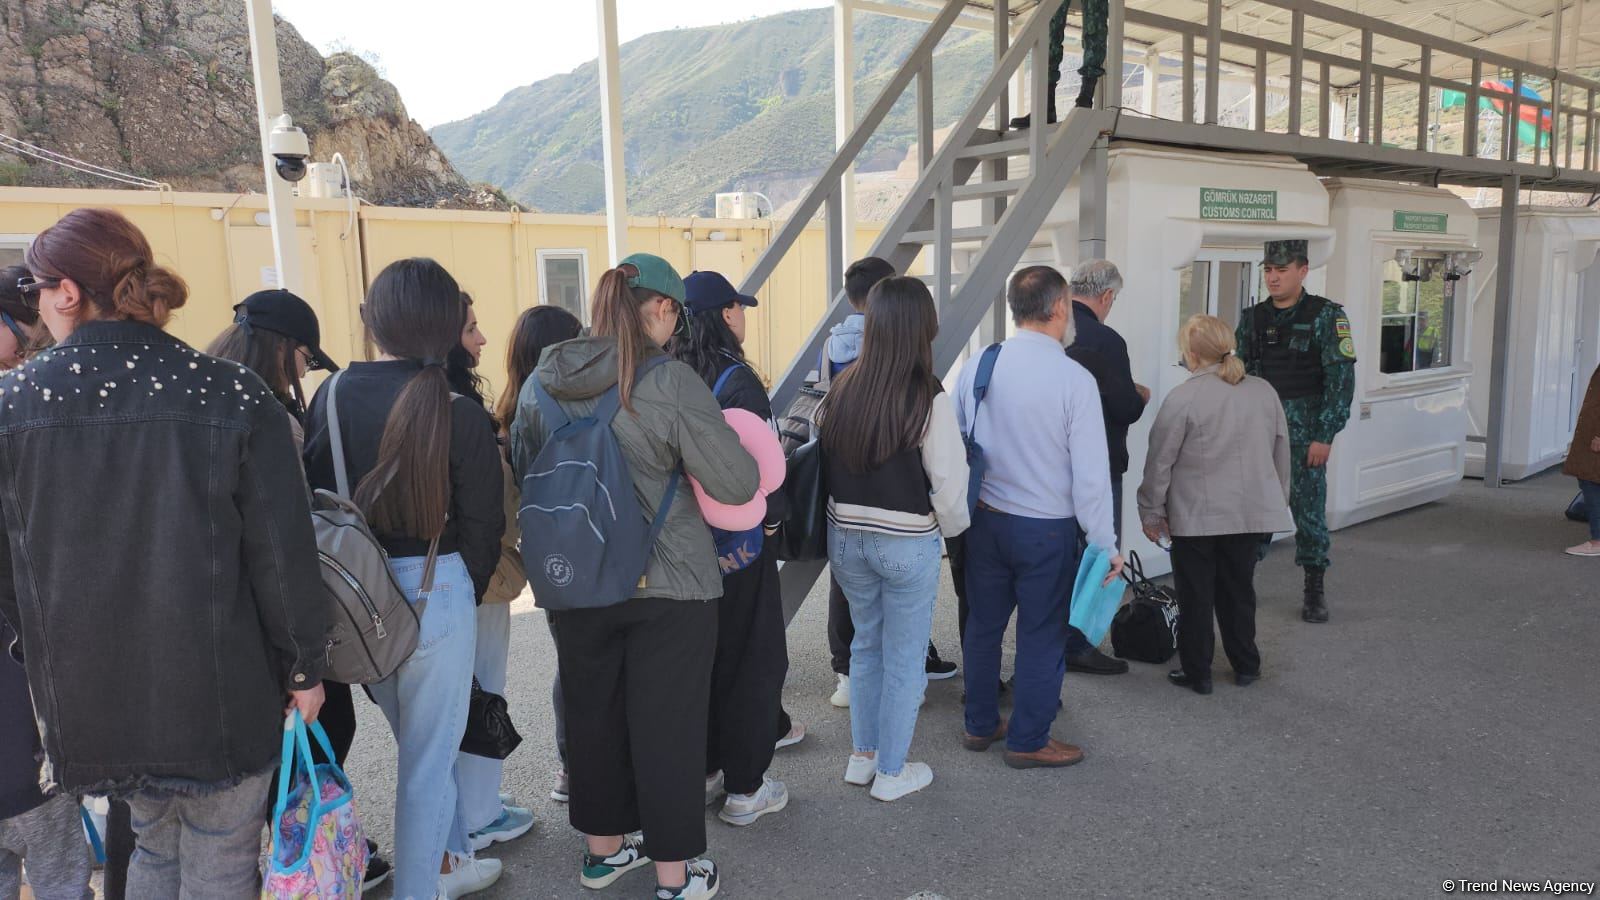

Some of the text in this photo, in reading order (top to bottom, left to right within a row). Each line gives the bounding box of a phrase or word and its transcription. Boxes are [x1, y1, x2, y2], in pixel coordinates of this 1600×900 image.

[1203, 190, 1238, 204] GÖMRÜK
[1202, 206, 1275, 219] CUSTOMS CONTROL
[718, 540, 756, 574] NK
